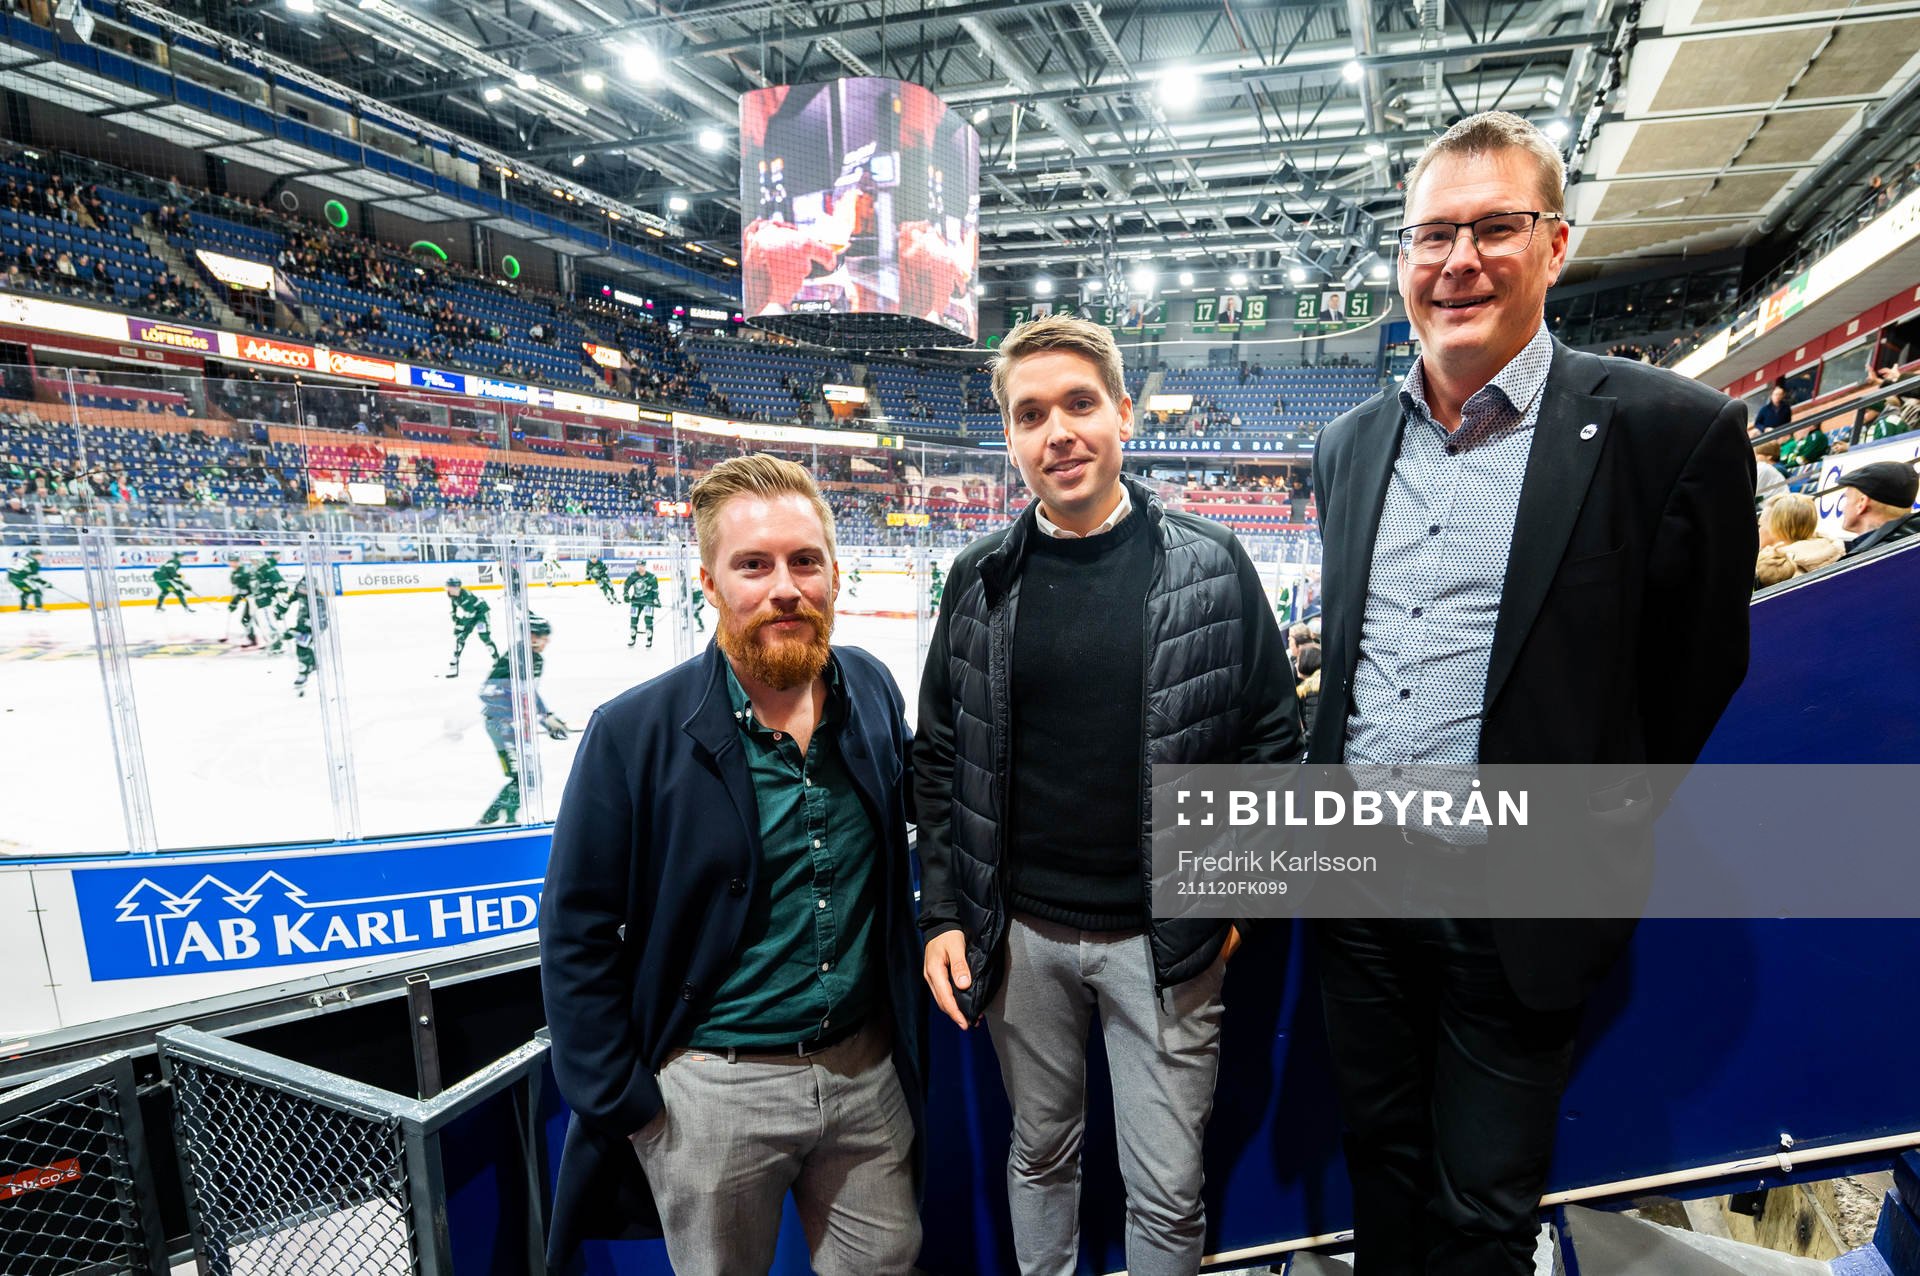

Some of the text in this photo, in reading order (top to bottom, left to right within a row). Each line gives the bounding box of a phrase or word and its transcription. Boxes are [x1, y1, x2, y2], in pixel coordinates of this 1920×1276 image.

[1197, 304, 1213, 321] 17
[1247, 301, 1264, 319] 19
[1297, 300, 1315, 317] 21
[1351, 298, 1368, 316] 51
[141, 327, 209, 350] LÖFBERGS
[244, 340, 310, 367] Adecco
[1232, 440, 1241, 450] &
[1253, 441, 1284, 451] BAR
[358, 574, 420, 586] LÖFBERGS
[175, 892, 542, 965] AB KARL HED
